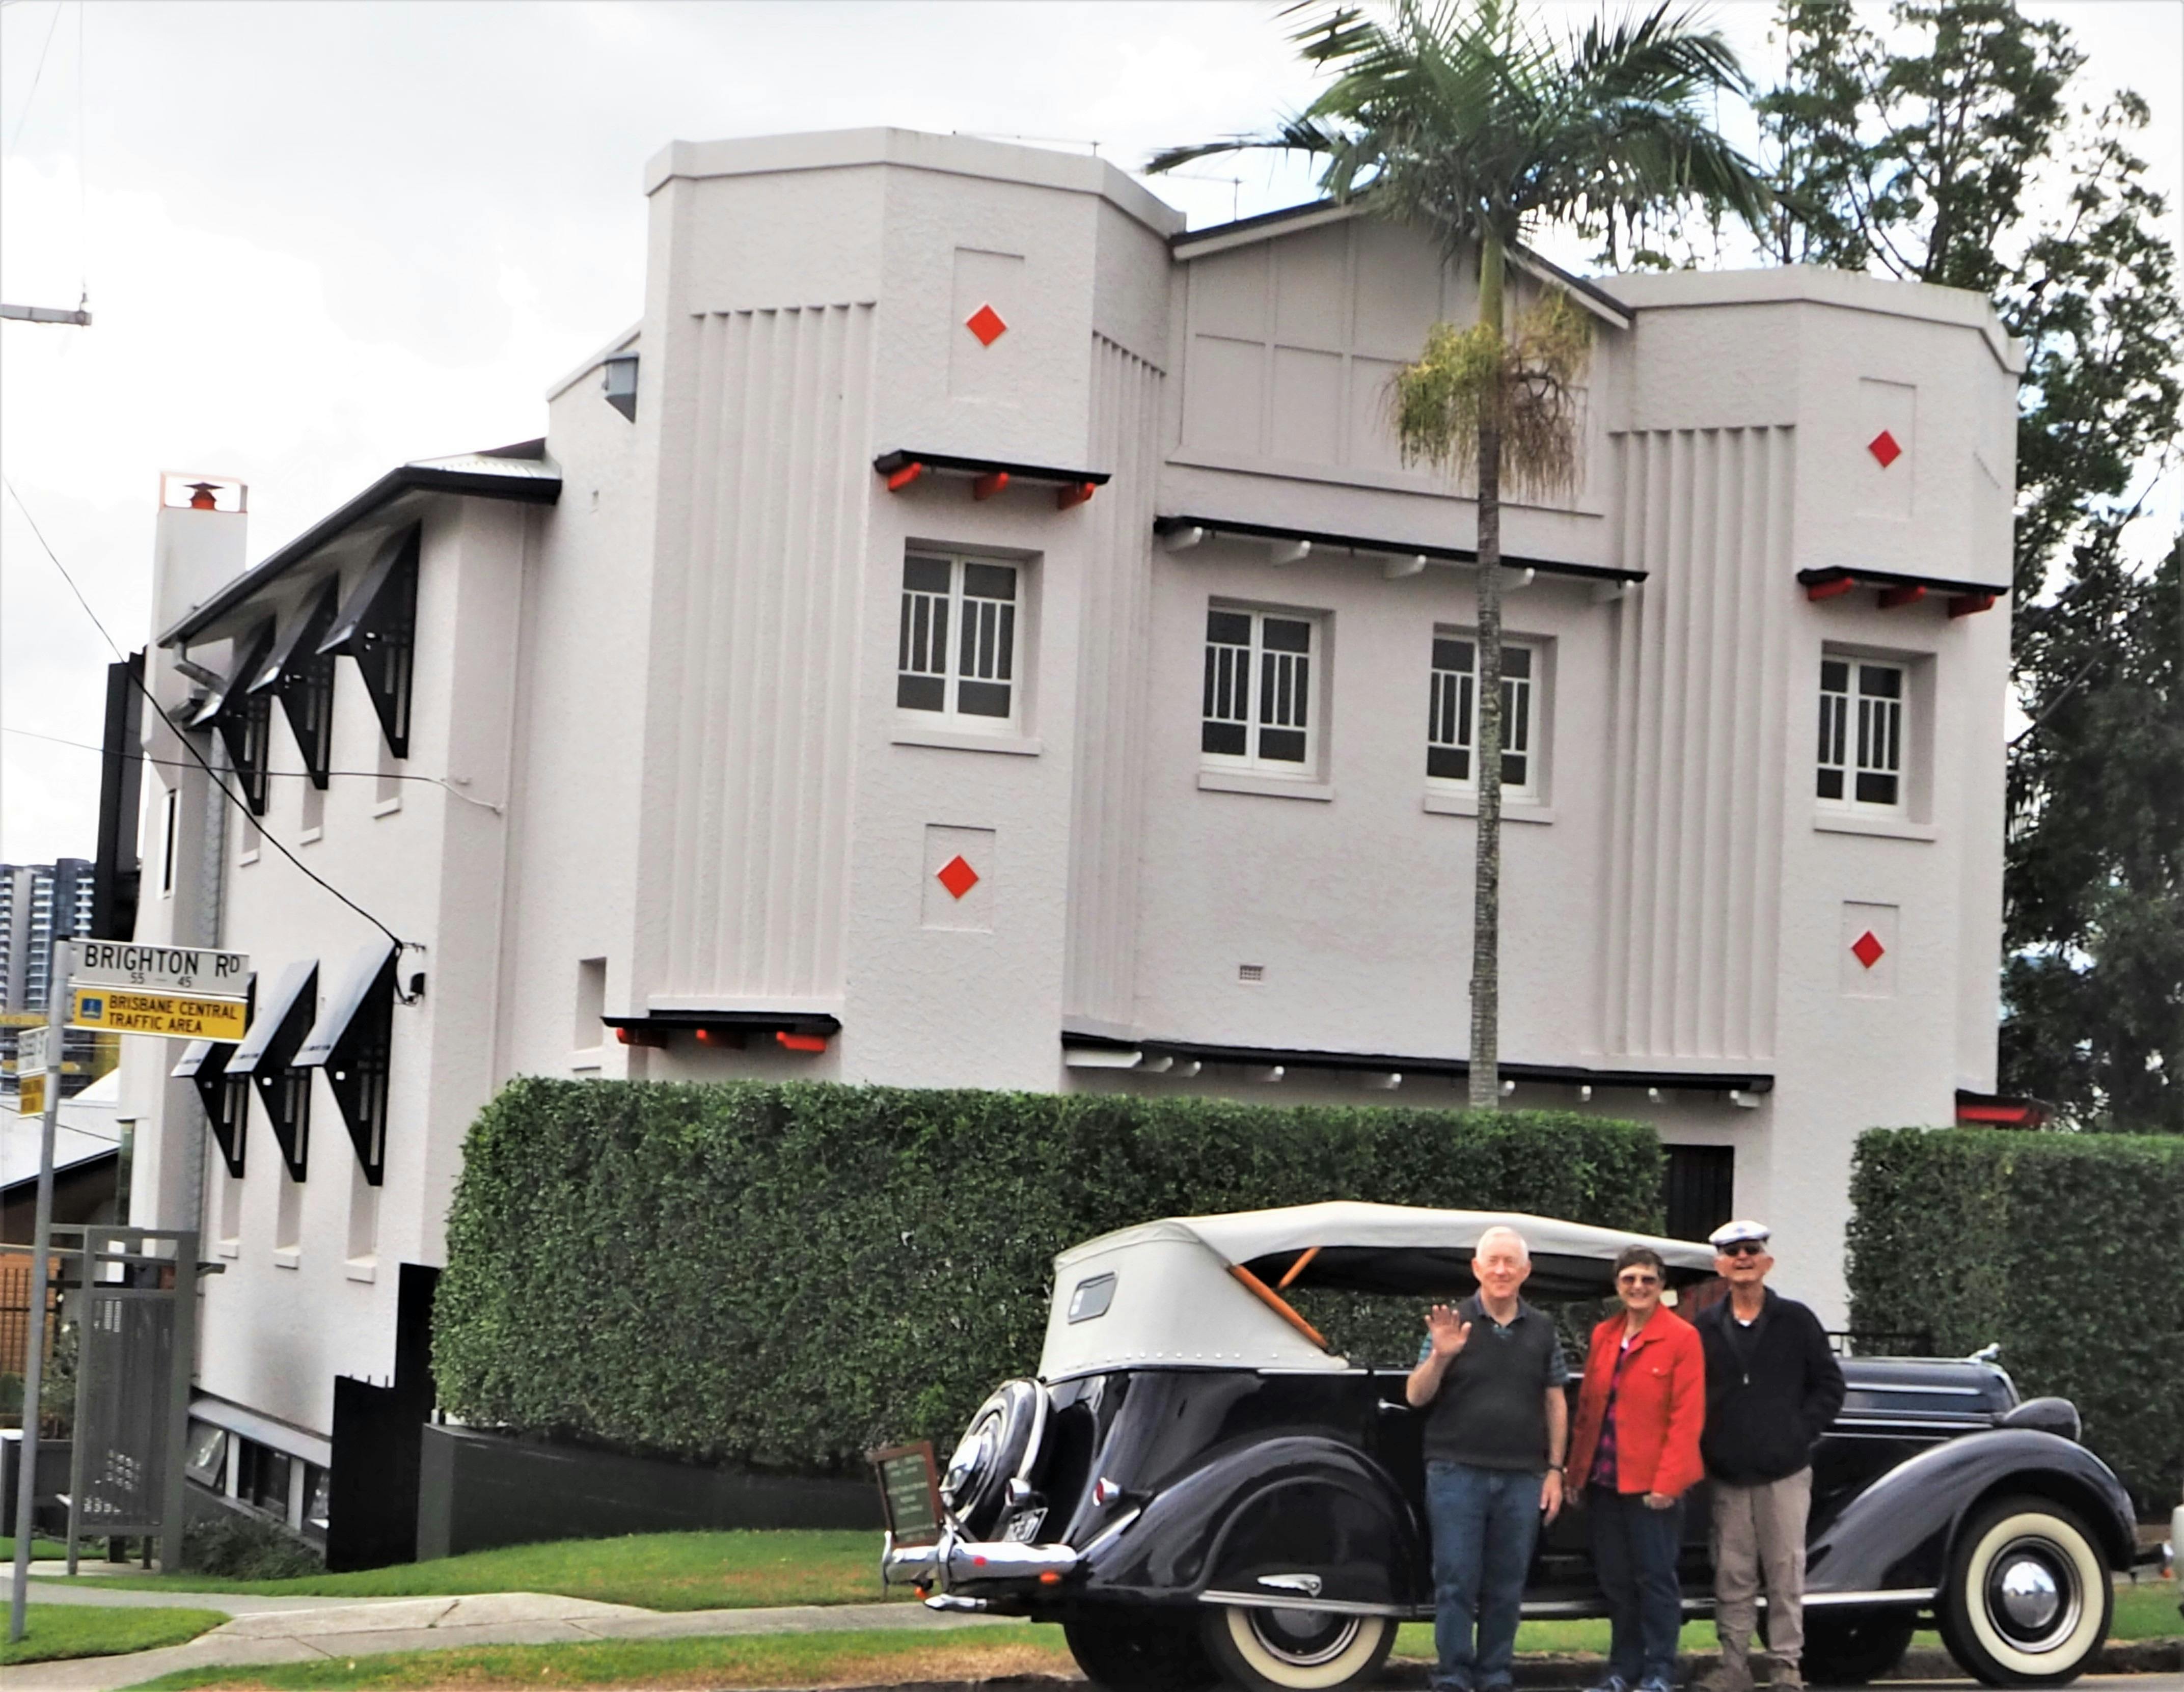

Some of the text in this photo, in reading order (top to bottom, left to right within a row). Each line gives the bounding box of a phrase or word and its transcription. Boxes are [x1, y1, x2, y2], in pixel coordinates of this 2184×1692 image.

[85, 945, 240, 977] BRIGHTON RD
[131, 972, 145, 985] 55
[177, 976, 192, 988] 45
[110, 995, 237, 1020] BRISBANE CENTRAL
[109, 1012, 202, 1033] TRAFFIC AREA
